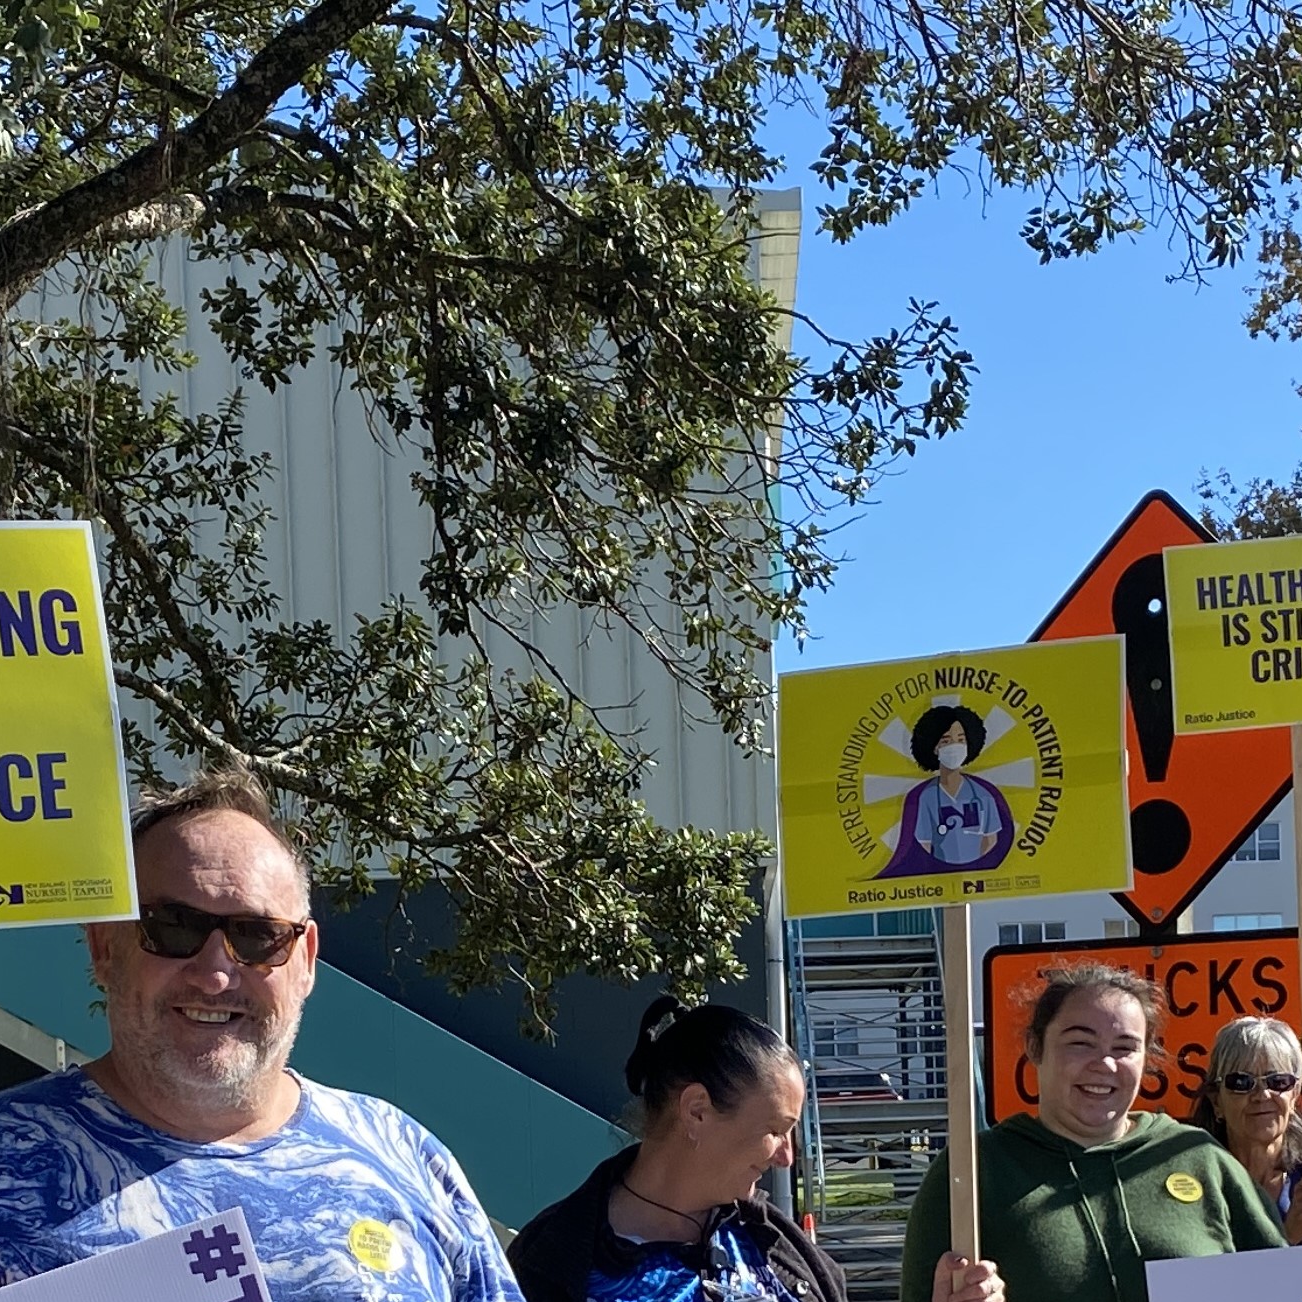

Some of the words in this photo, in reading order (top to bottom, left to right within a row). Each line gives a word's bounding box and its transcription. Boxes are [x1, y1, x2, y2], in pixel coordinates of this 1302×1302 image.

[1221, 612, 1250, 647] IS
[1185, 711, 1214, 724] Ratio
[1216, 708, 1256, 722] Justice
[836, 716, 879, 804] STANDING
[869, 693, 894, 721] UP
[894, 672, 932, 704] FOR
[934, 667, 1064, 780] NURSE-TO-PATIENT
[1017, 786, 1062, 858] RATIOS
[848, 888, 886, 904] Ratio
[889, 884, 944, 900] Justice
